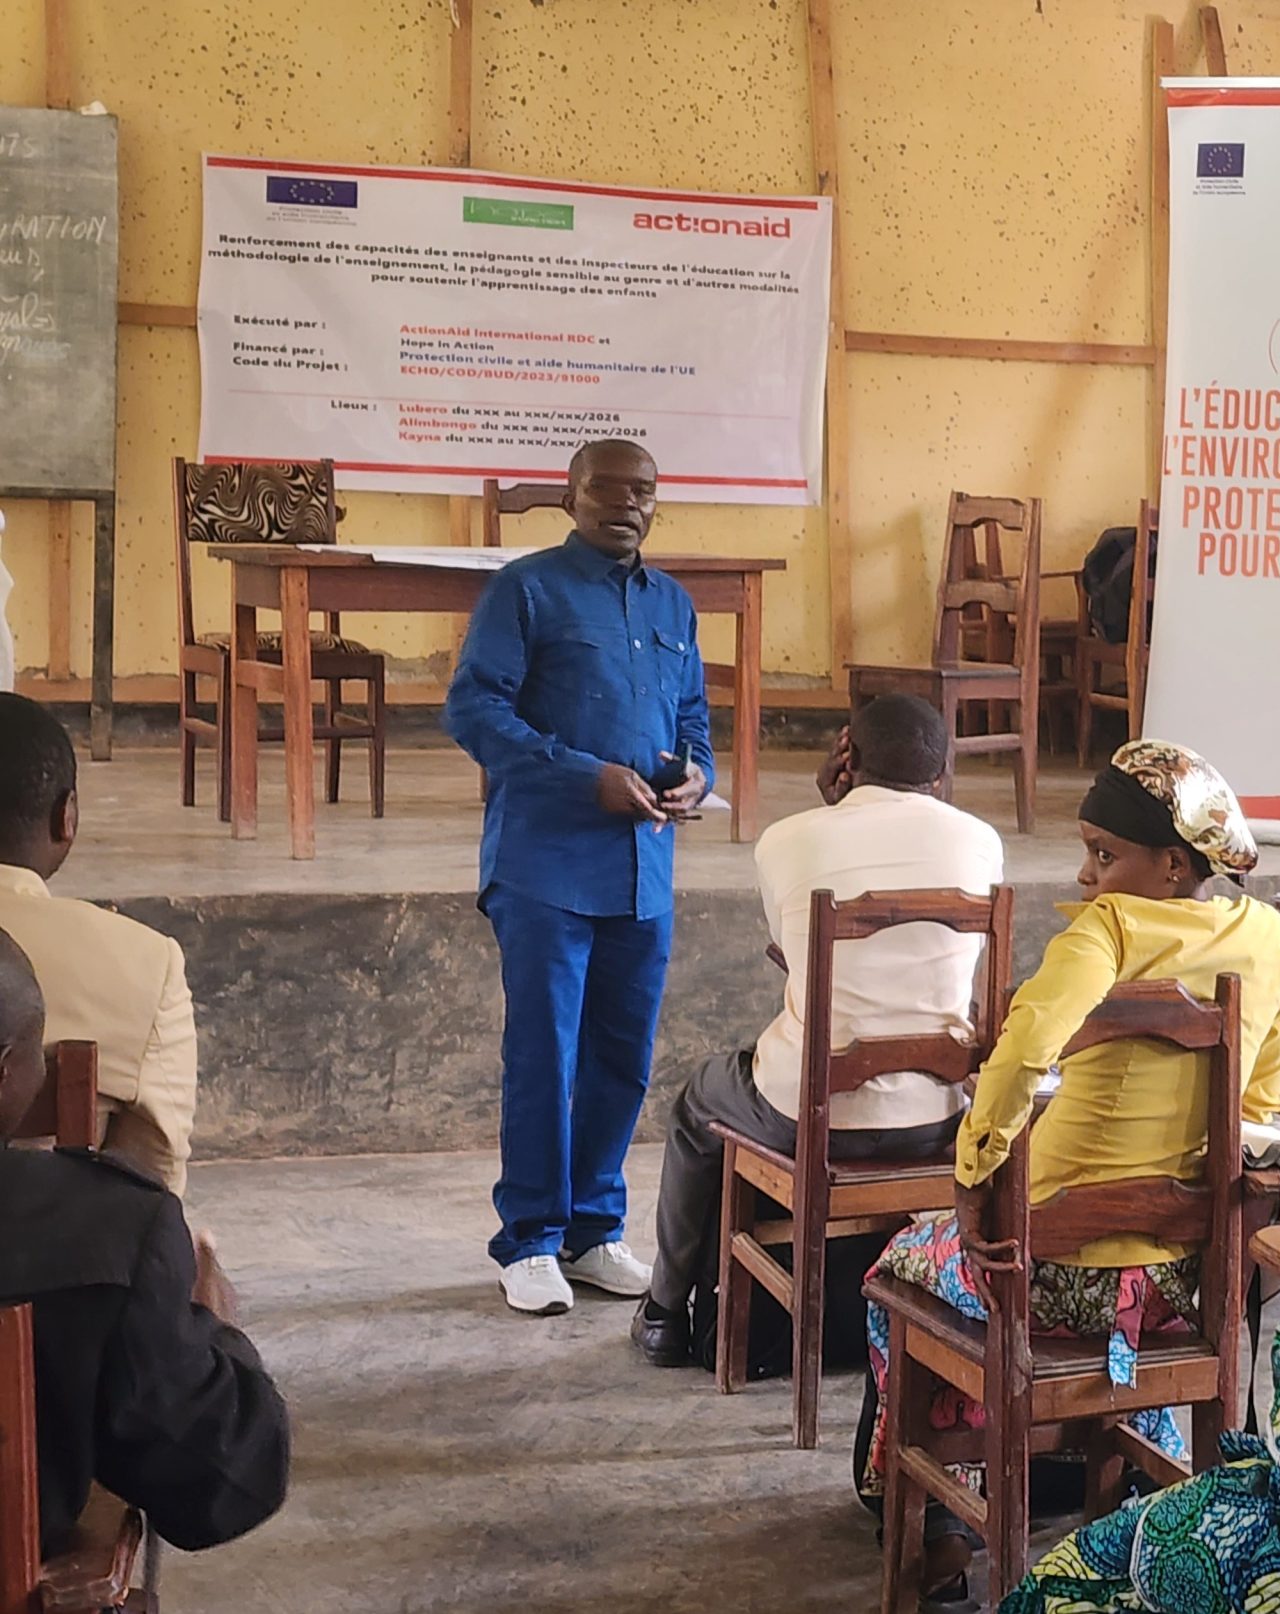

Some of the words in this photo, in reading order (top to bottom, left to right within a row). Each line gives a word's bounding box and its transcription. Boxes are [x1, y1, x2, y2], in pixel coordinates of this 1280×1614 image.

[219, 234, 321, 249] Renforcement
[326, 241, 350, 251] des
[355, 243, 419, 255] capacités
[424, 247, 448, 257] des
[452, 250, 534, 263] enseignants
[538, 256, 552, 265] et
[556, 257, 578, 266] des
[582, 257, 658, 271] inspecteurs
[662, 263, 677, 272] de
[682, 264, 754, 278] l'éducation
[759, 272, 777, 280] sur
[780, 271, 791, 280] la
[208, 249, 310, 264] méthodologie
[314, 254, 331, 264] de
[454, 262, 466, 272] la
[470, 265, 542, 278] pédagogie
[546, 270, 600, 281] sensible
[604, 275, 619, 283] au
[623, 277, 662, 286] genre
[666, 278, 679, 286] et
[683, 278, 735, 290] d'autres
[740, 282, 800, 294] modalités
[371, 273, 405, 283] pour
[409, 275, 468, 286] soutenir
[472, 277, 576, 295] l'apprentissage
[580, 285, 603, 295] des
[607, 287, 657, 298] enfants
[234, 315, 290, 327] Exécuté
[294, 320, 318, 330] par
[400, 324, 471, 337] ActionAid
[475, 328, 564, 342] International
[567, 334, 595, 344] RDC
[599, 337, 610, 345] et
[233, 342, 287, 353] Financé
[292, 346, 316, 356] par
[401, 338, 434, 349] Hope
[454, 341, 495, 351] Action
[233, 356, 270, 367] Code
[274, 358, 292, 368] du
[296, 360, 340, 372] Projet
[400, 351, 474, 364] Protection
[478, 355, 513, 366] civile
[518, 358, 531, 366] et
[535, 358, 563, 368] aide
[567, 360, 647, 373] humanitaire
[651, 365, 666, 374] de
[331, 400, 369, 411] Lieux
[399, 404, 448, 415] Lubero
[452, 406, 470, 415] du
[474, 408, 500, 416] xxx
[504, 409, 520, 417] au
[399, 418, 477, 431] Alimbongo
[481, 421, 498, 431] du
[503, 424, 528, 432] xxx
[533, 425, 548, 433] au
[399, 431, 441, 443] Kayna
[446, 434, 463, 443] du
[468, 435, 493, 443] xxx
[498, 437, 514, 445] au
[1197, 532, 1280, 579] POUR
